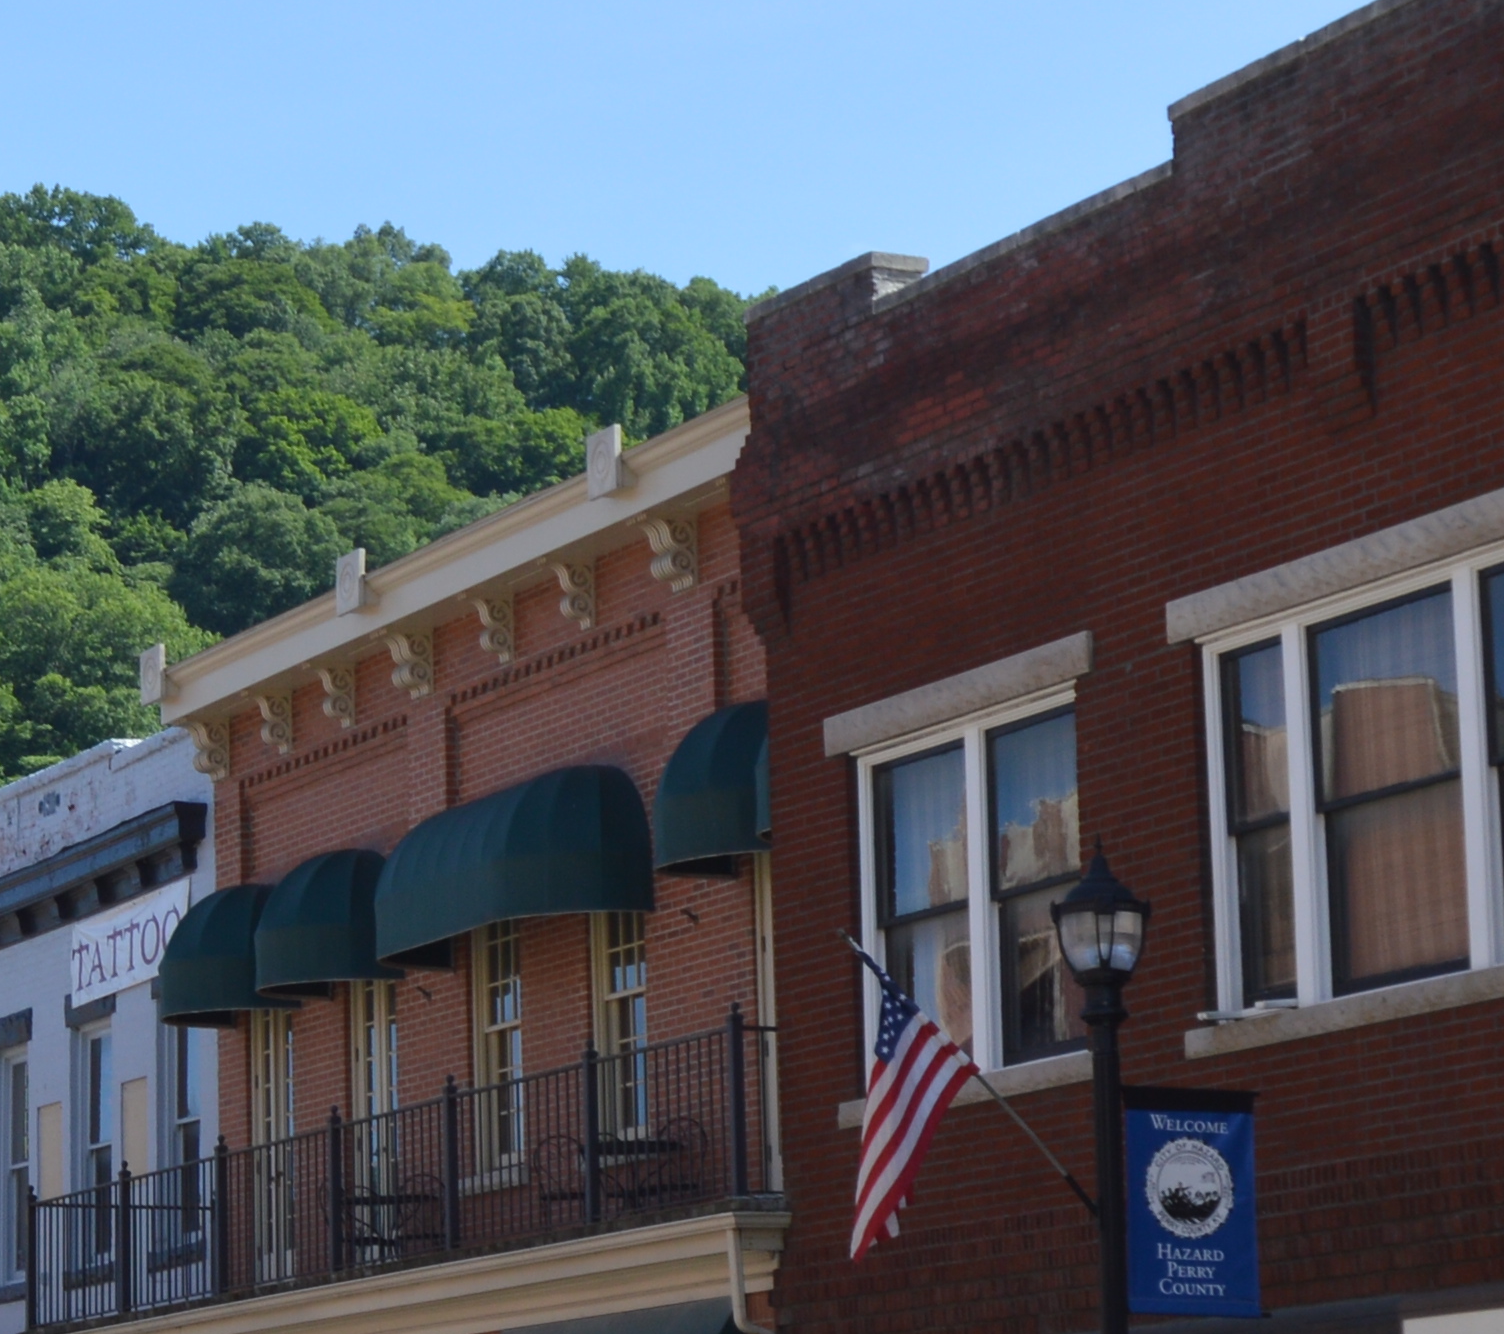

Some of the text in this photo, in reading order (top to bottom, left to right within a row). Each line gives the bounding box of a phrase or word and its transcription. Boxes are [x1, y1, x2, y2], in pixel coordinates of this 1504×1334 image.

[1150, 1113, 1229, 1134] WELCOME
[1156, 1243, 1225, 1261] HAZARD
[1167, 1261, 1216, 1279] PERRY
[1159, 1278, 1226, 1296] COUNTY
